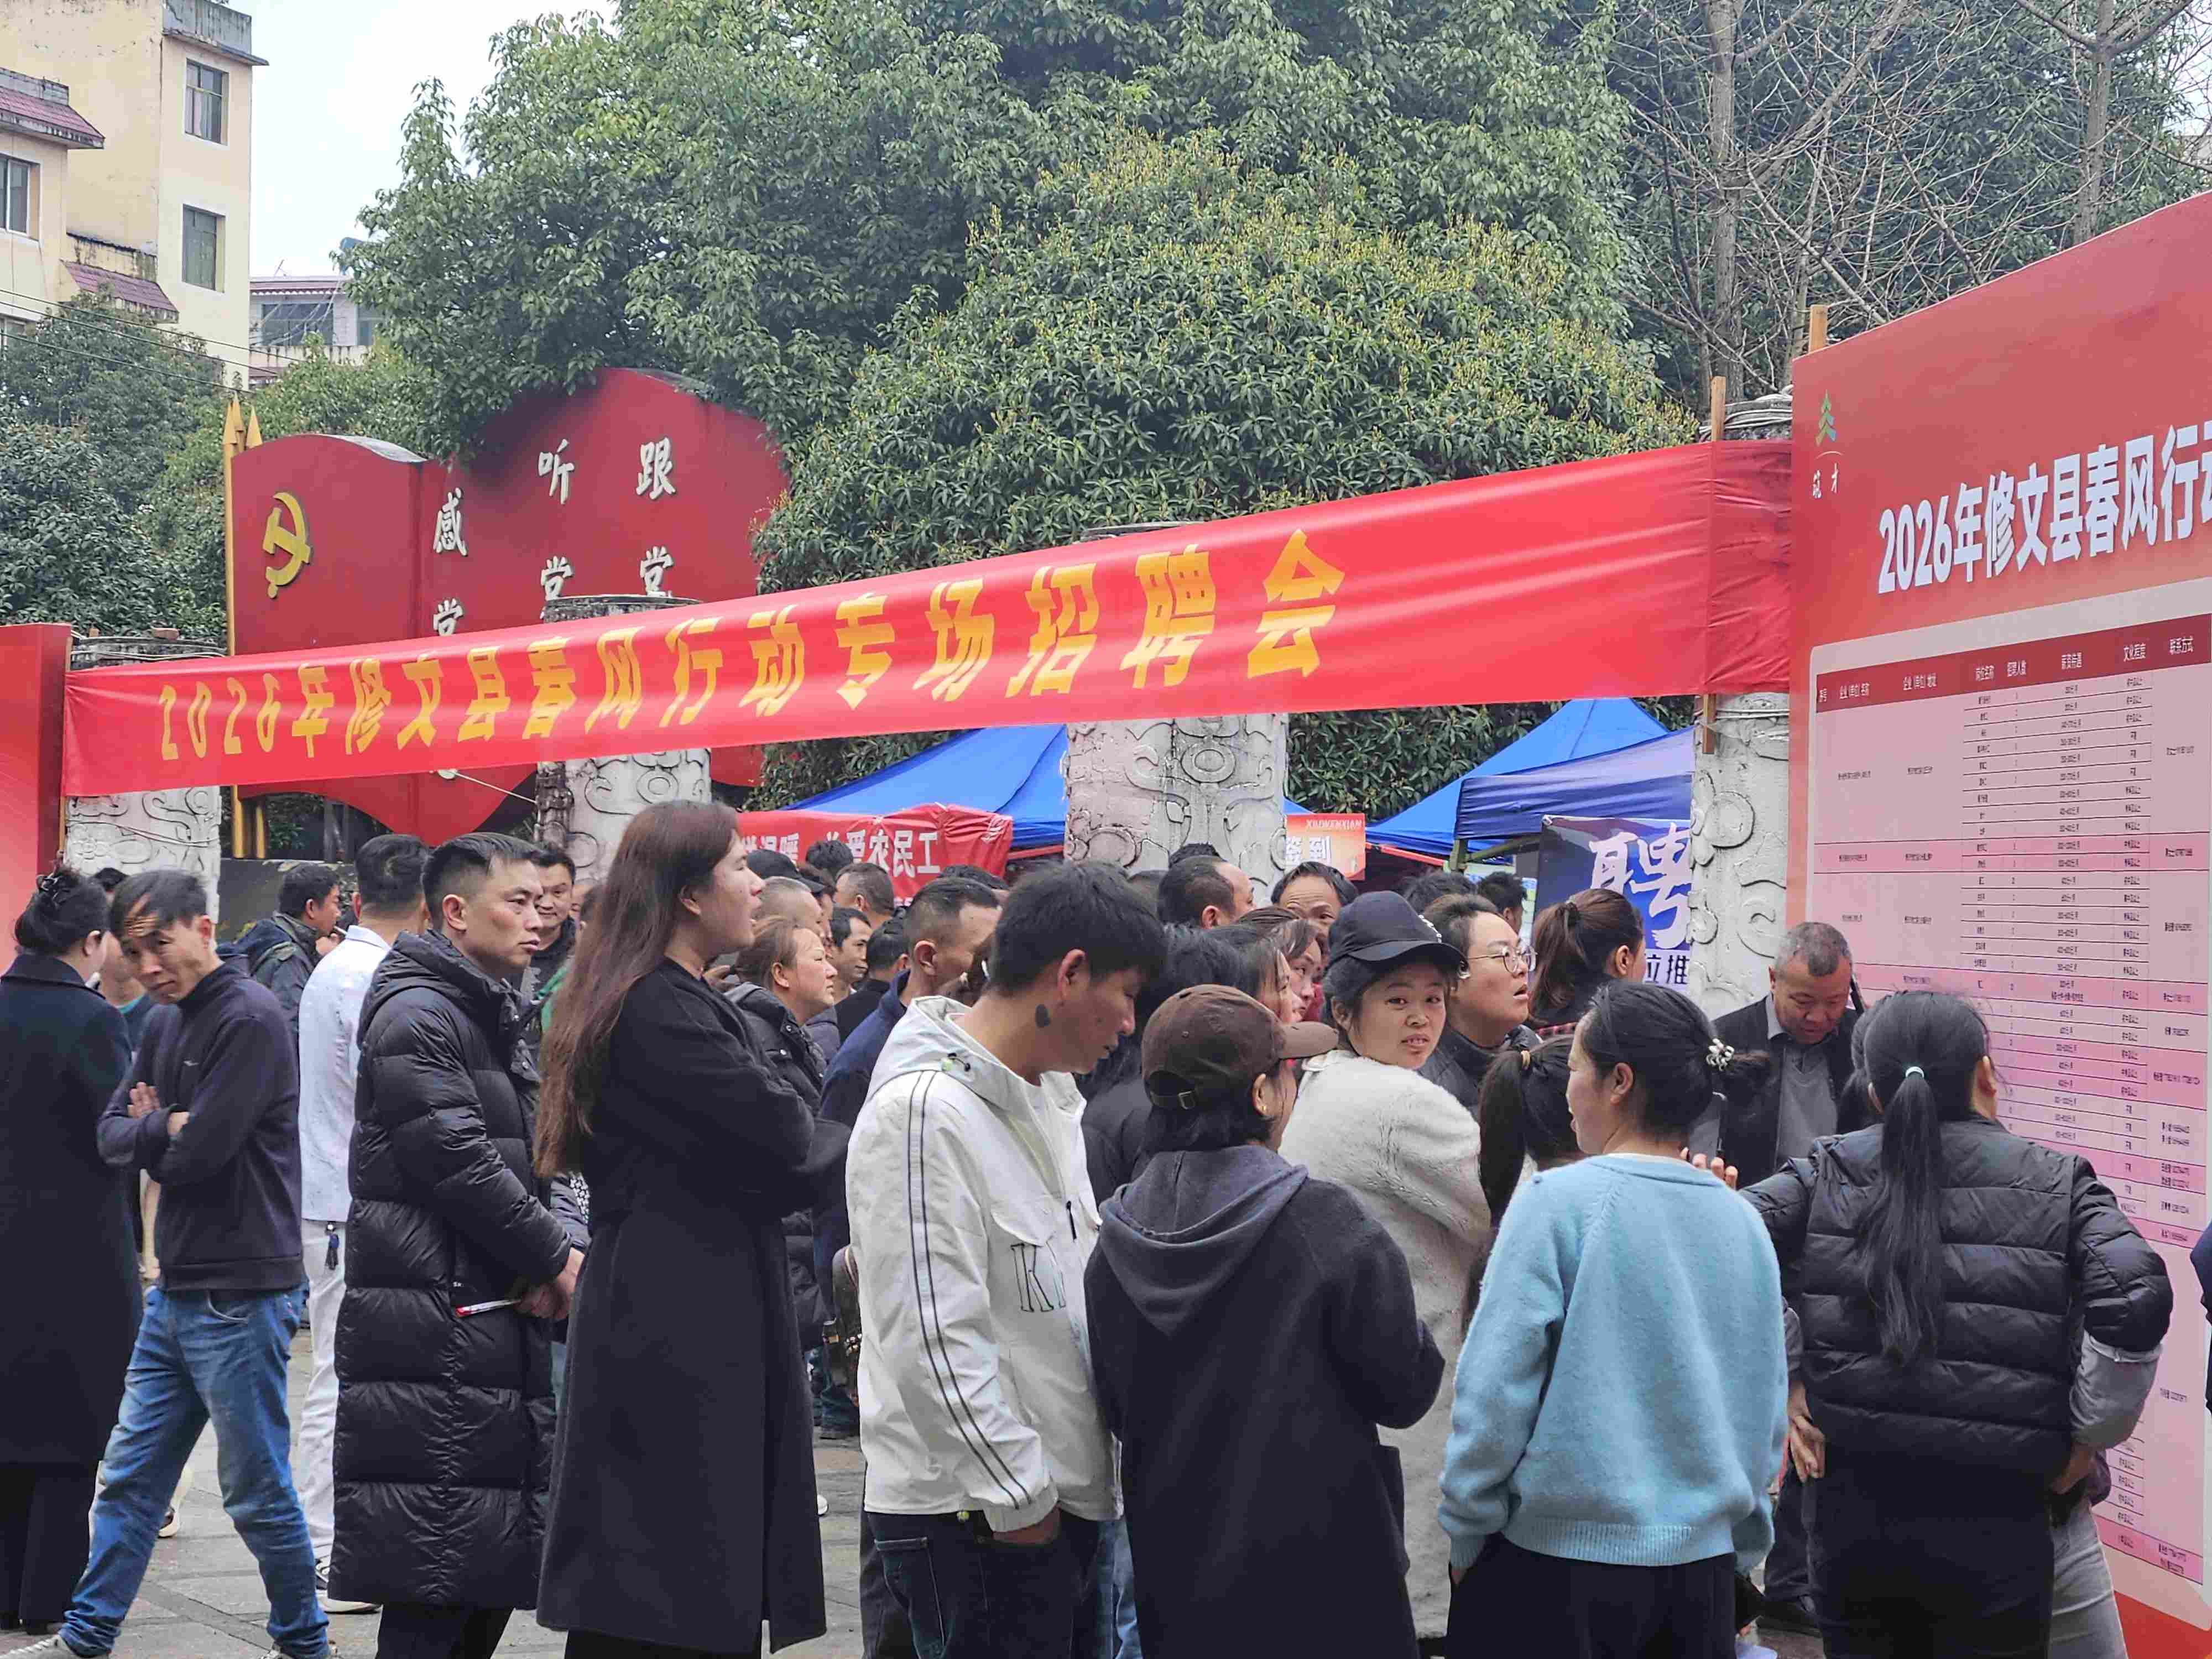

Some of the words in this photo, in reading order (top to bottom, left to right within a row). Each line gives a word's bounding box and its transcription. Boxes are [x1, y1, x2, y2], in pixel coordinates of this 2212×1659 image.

[1878, 420, 2212, 594] 2026年修文县春风行
[159, 529, 1345, 761] 2026年修文县春风行动专场招聘会
[826, 828, 941, 878] 爱农民工
